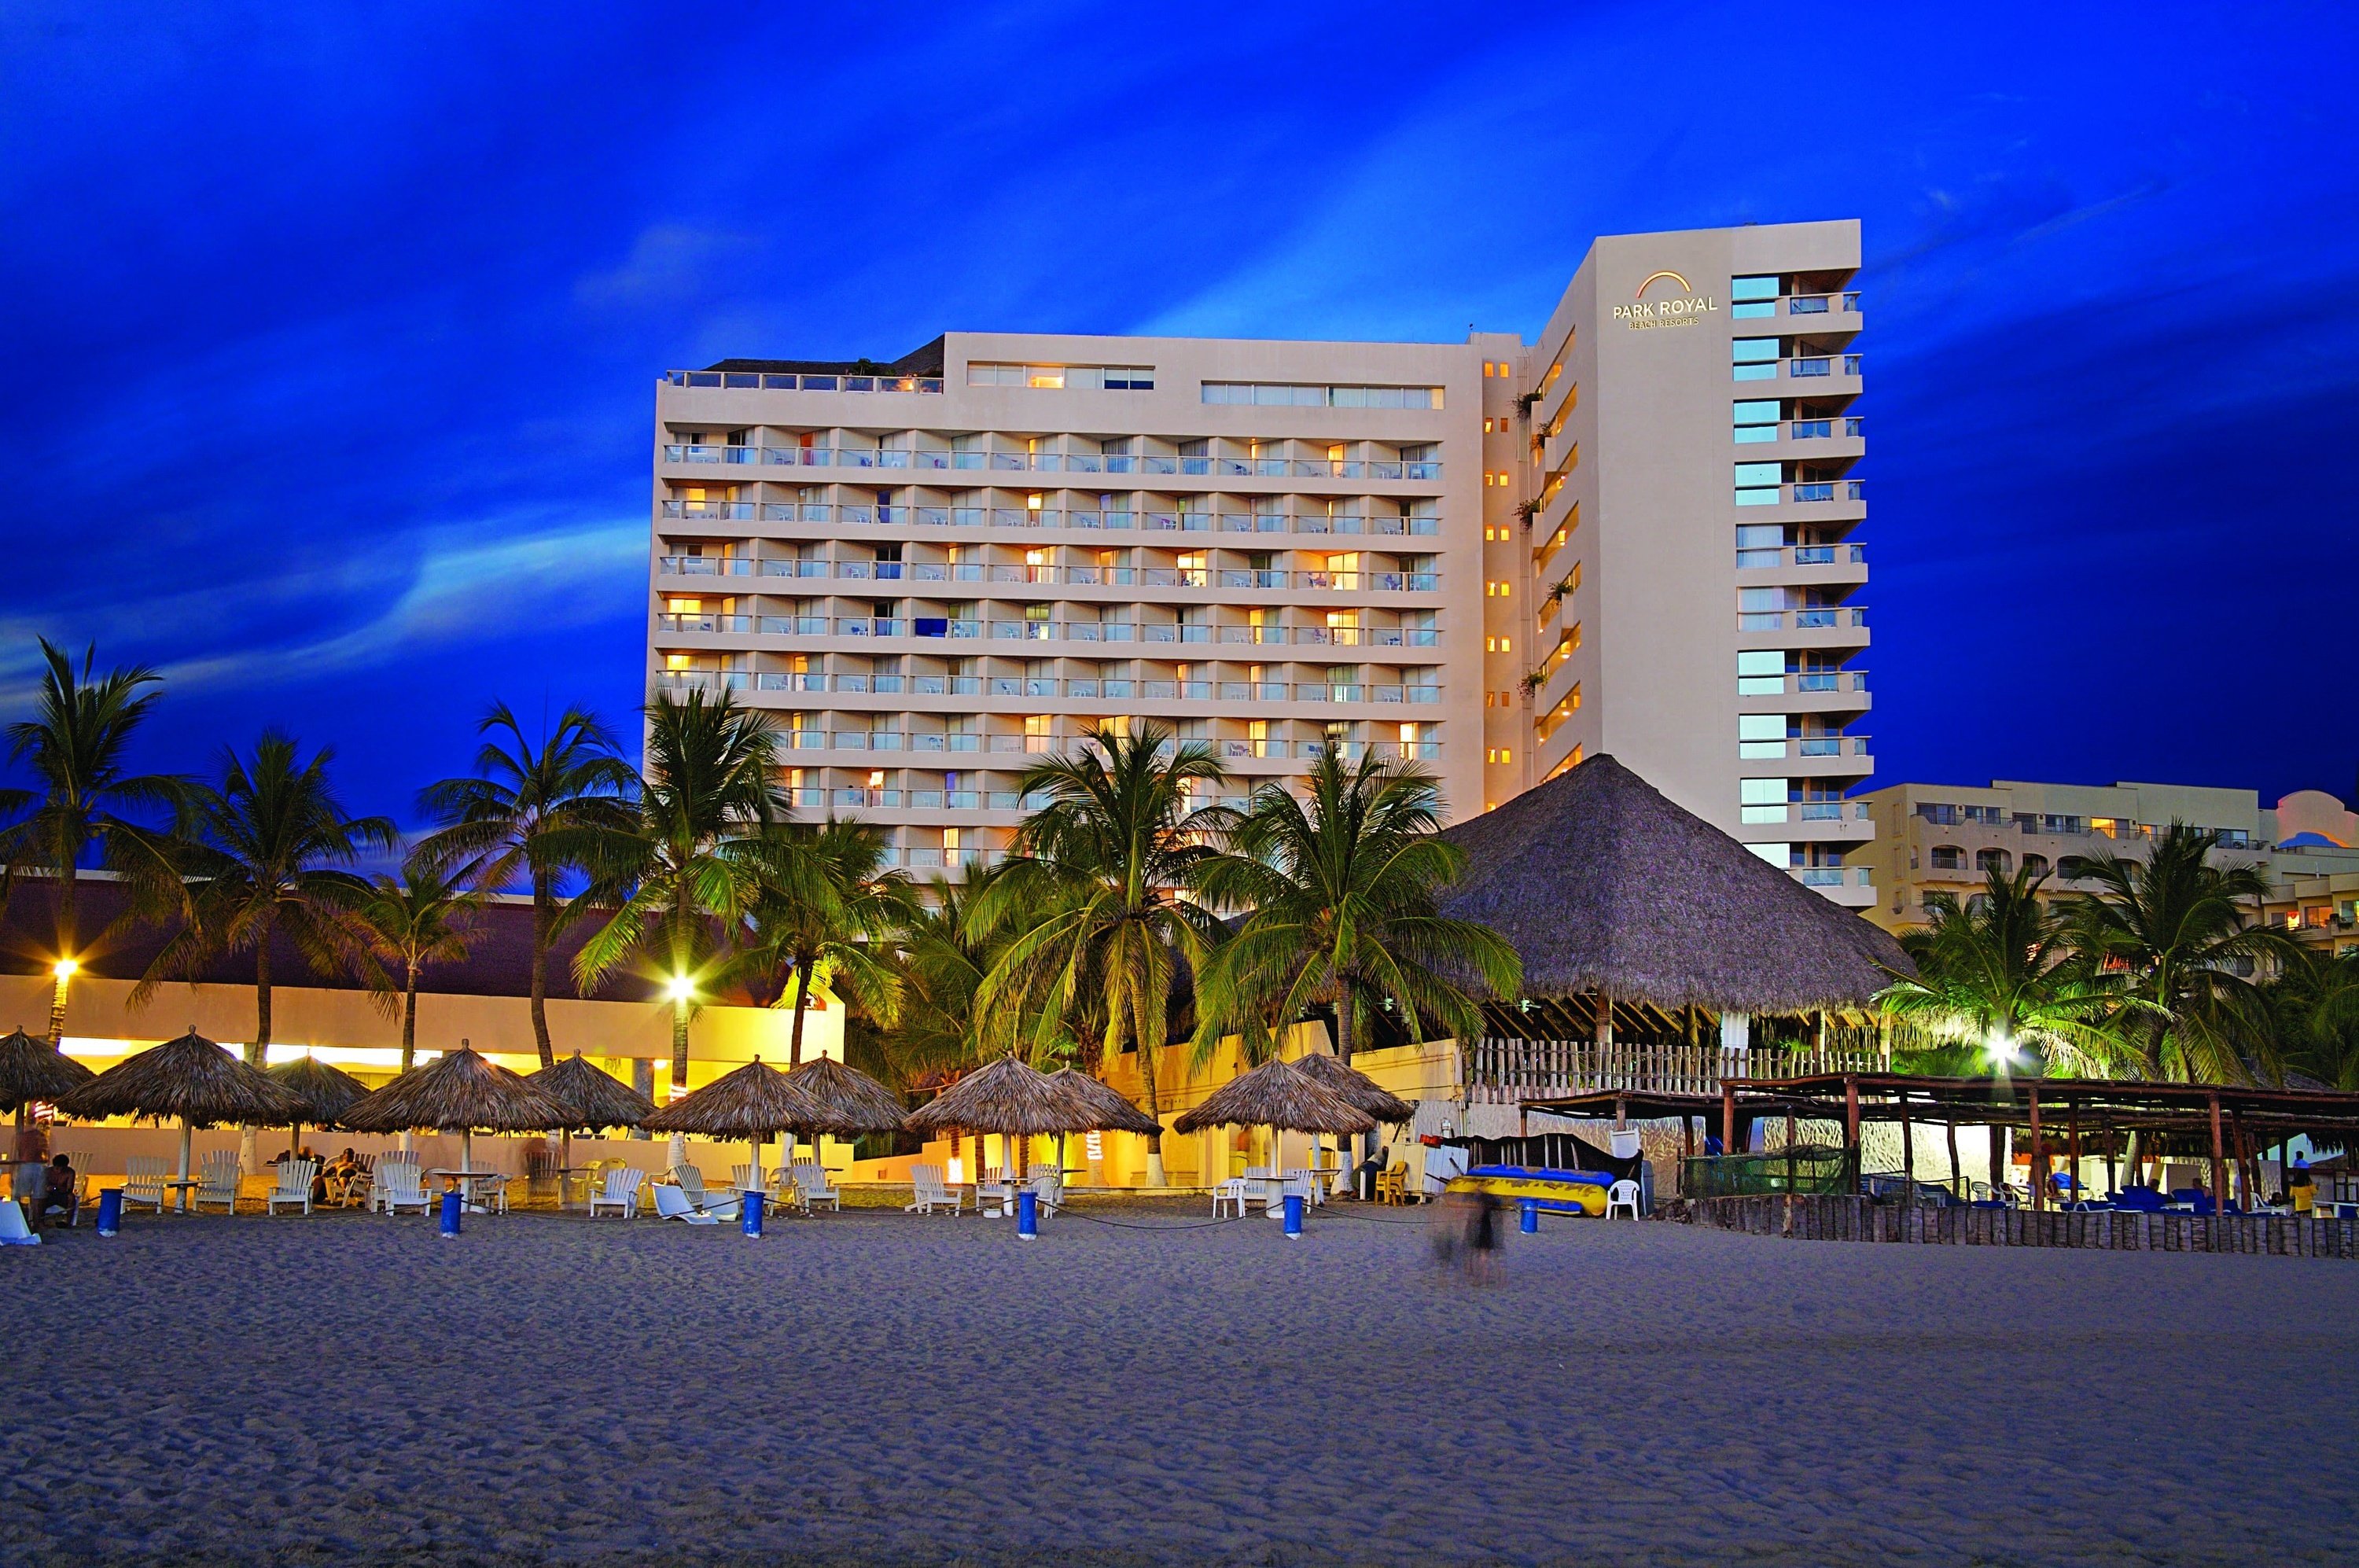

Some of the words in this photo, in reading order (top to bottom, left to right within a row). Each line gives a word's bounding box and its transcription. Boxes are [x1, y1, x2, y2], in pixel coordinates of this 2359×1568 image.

[1614, 303, 1654, 319] PARK
[1660, 296, 1717, 315] ROYAL
[1629, 320, 1657, 330] BEACH
[1660, 317, 1698, 327] RESORTS
